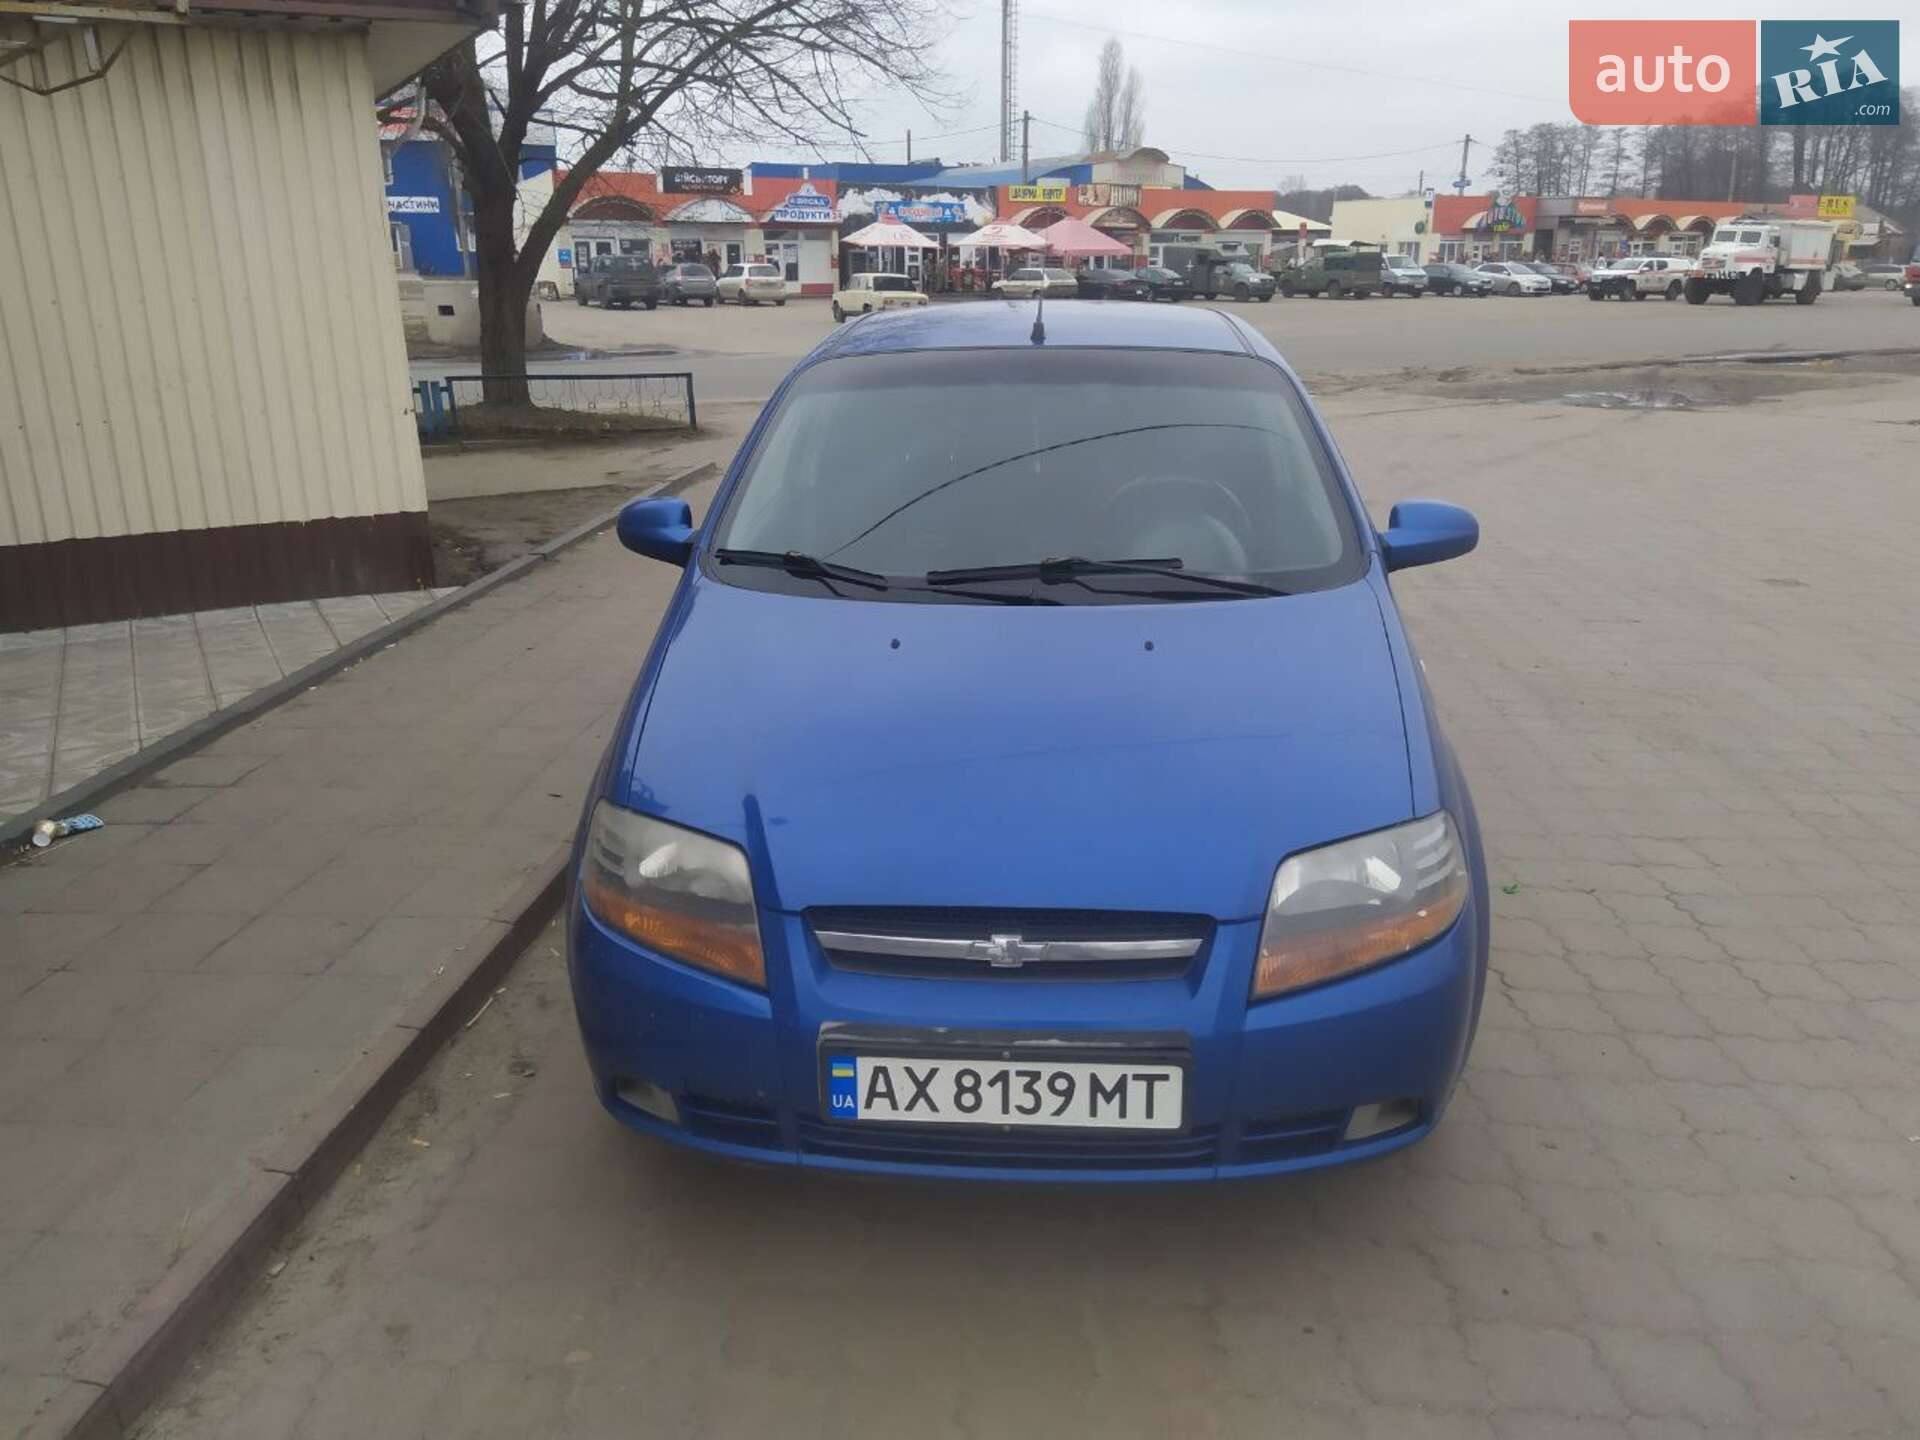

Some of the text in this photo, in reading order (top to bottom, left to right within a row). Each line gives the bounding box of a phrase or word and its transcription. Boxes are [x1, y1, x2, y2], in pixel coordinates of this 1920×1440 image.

[775, 209, 830, 220] ПРОДУКТИ
[864, 1065, 1170, 1120] AX 8139 MT
[832, 1095, 855, 1109] UA
